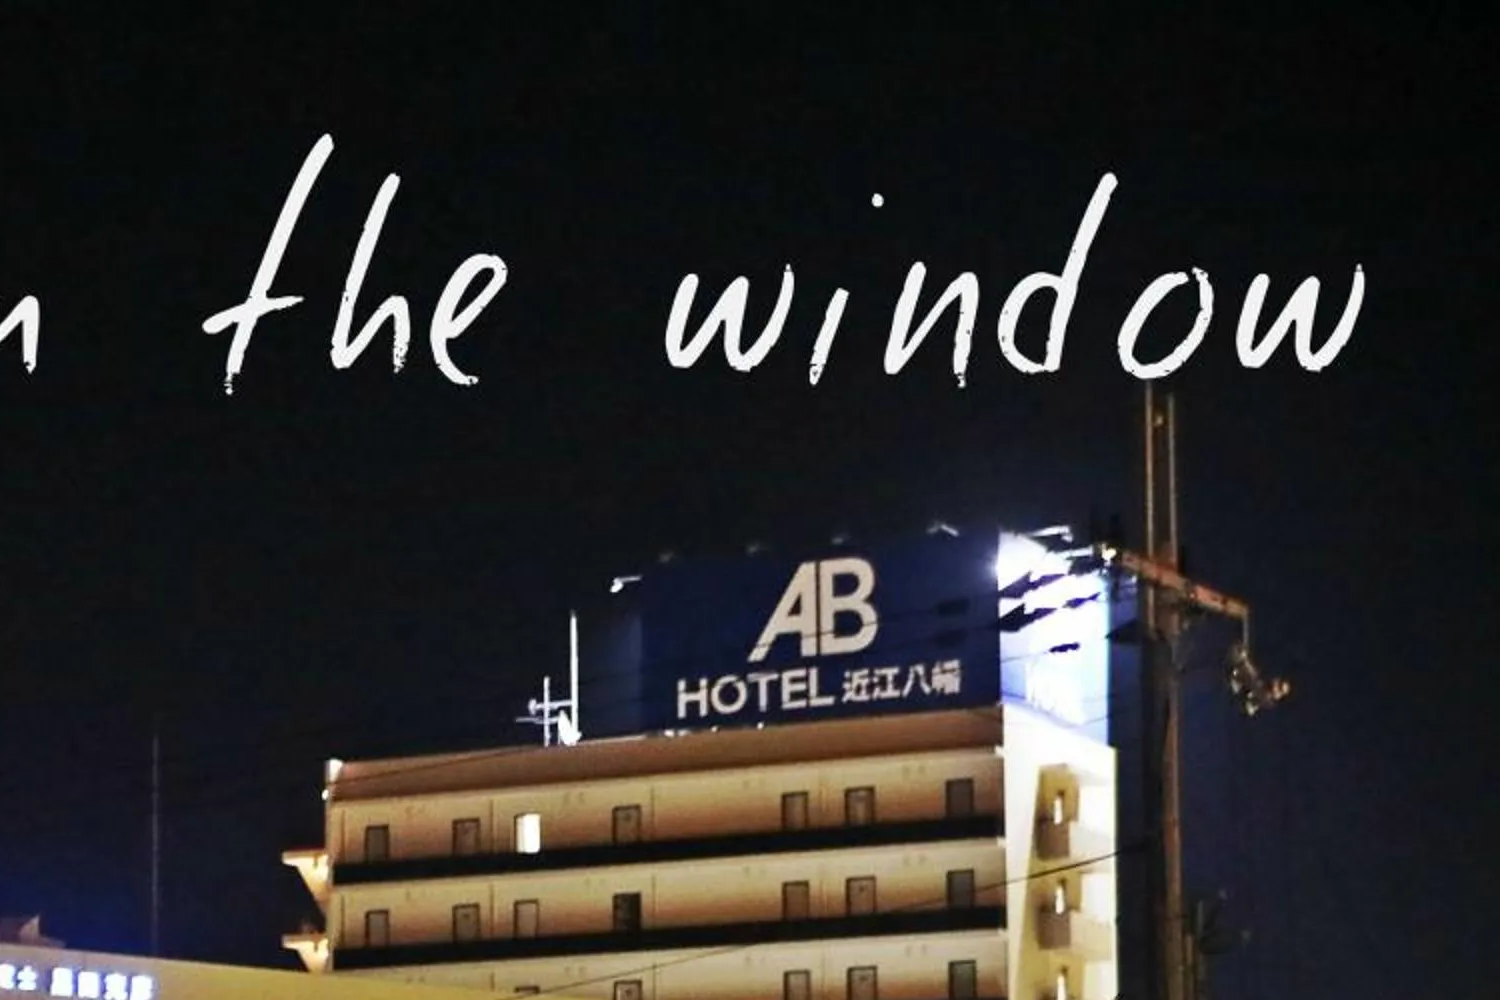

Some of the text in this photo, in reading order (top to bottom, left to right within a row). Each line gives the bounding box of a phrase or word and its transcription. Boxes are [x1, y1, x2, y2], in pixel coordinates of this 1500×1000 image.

[748, 557, 878, 662] AB
[677, 659, 962, 719] HOTEL 近江八幡
